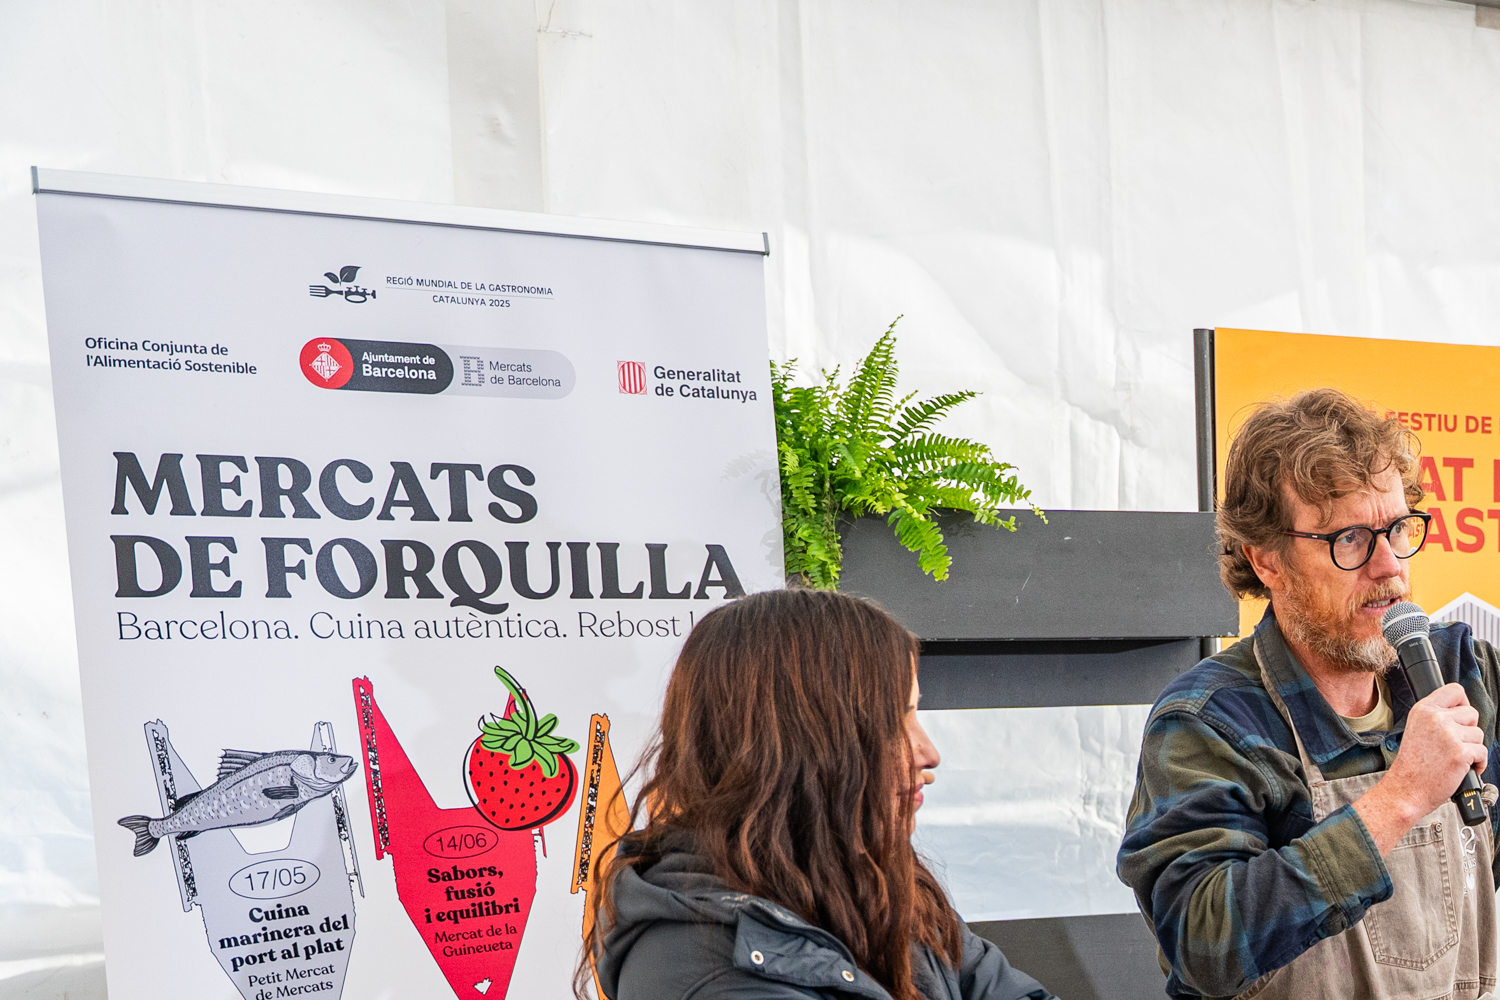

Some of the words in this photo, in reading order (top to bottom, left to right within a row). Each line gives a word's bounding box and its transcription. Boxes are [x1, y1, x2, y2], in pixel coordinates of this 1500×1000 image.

[386, 276, 414, 286] REGIÓ
[416, 278, 458, 289] MUNDIAL
[460, 281, 472, 290] DE
[475, 282, 486, 291] LA
[488, 283, 553, 295] GASTRONOMIA
[432, 294, 486, 306] CATALUNYA
[489, 298, 511, 308] 2025
[84, 337, 138, 351] Oficina
[141, 339, 208, 356] Conjunta
[210, 343, 229, 356] de
[86, 354, 182, 371] l'Alimentació
[184, 359, 258, 375] Sostenible
[361, 351, 421, 365] Ajuntament
[422, 354, 436, 365] de
[489, 360, 533, 373] Mercats
[362, 364, 437, 380] Barcelona
[490, 375, 505, 386] de
[508, 375, 562, 388] Barcelona
[653, 365, 742, 383] Generalitat
[654, 383, 675, 397] de
[679, 383, 758, 404] Catalunya
[1465, 415, 1493, 434] DE
[109, 451, 540, 524] MERCATS
[1419, 456, 1475, 502] AT
[109, 535, 243, 600] DE
[259, 537, 747, 616] FORQUILLA
[115, 611, 300, 642] Barcelona.
[308, 611, 406, 641] Cuina
[412, 611, 568, 641] autèntica.
[576, 611, 683, 640] Rebost
[435, 832, 488, 852] 14/06
[244, 865, 307, 891] 17/05
[427, 865, 504, 883] Sabors,
[444, 880, 495, 901] fusió
[248, 903, 311, 923] Cuina
[424, 908, 432, 924] i
[436, 897, 521, 925] equilibri
[218, 924, 316, 949] marinera
[319, 913, 350, 934] del
[435, 928, 483, 944] Mercat
[486, 924, 502, 937] de
[505, 922, 518, 935] la
[230, 948, 278, 973] port
[280, 941, 300, 960] al
[303, 937, 345, 961] plat
[442, 940, 514, 957] Guineueta
[248, 971, 283, 987] Petit
[285, 963, 336, 981] Mercat
[276, 980, 334, 998] Mercats
